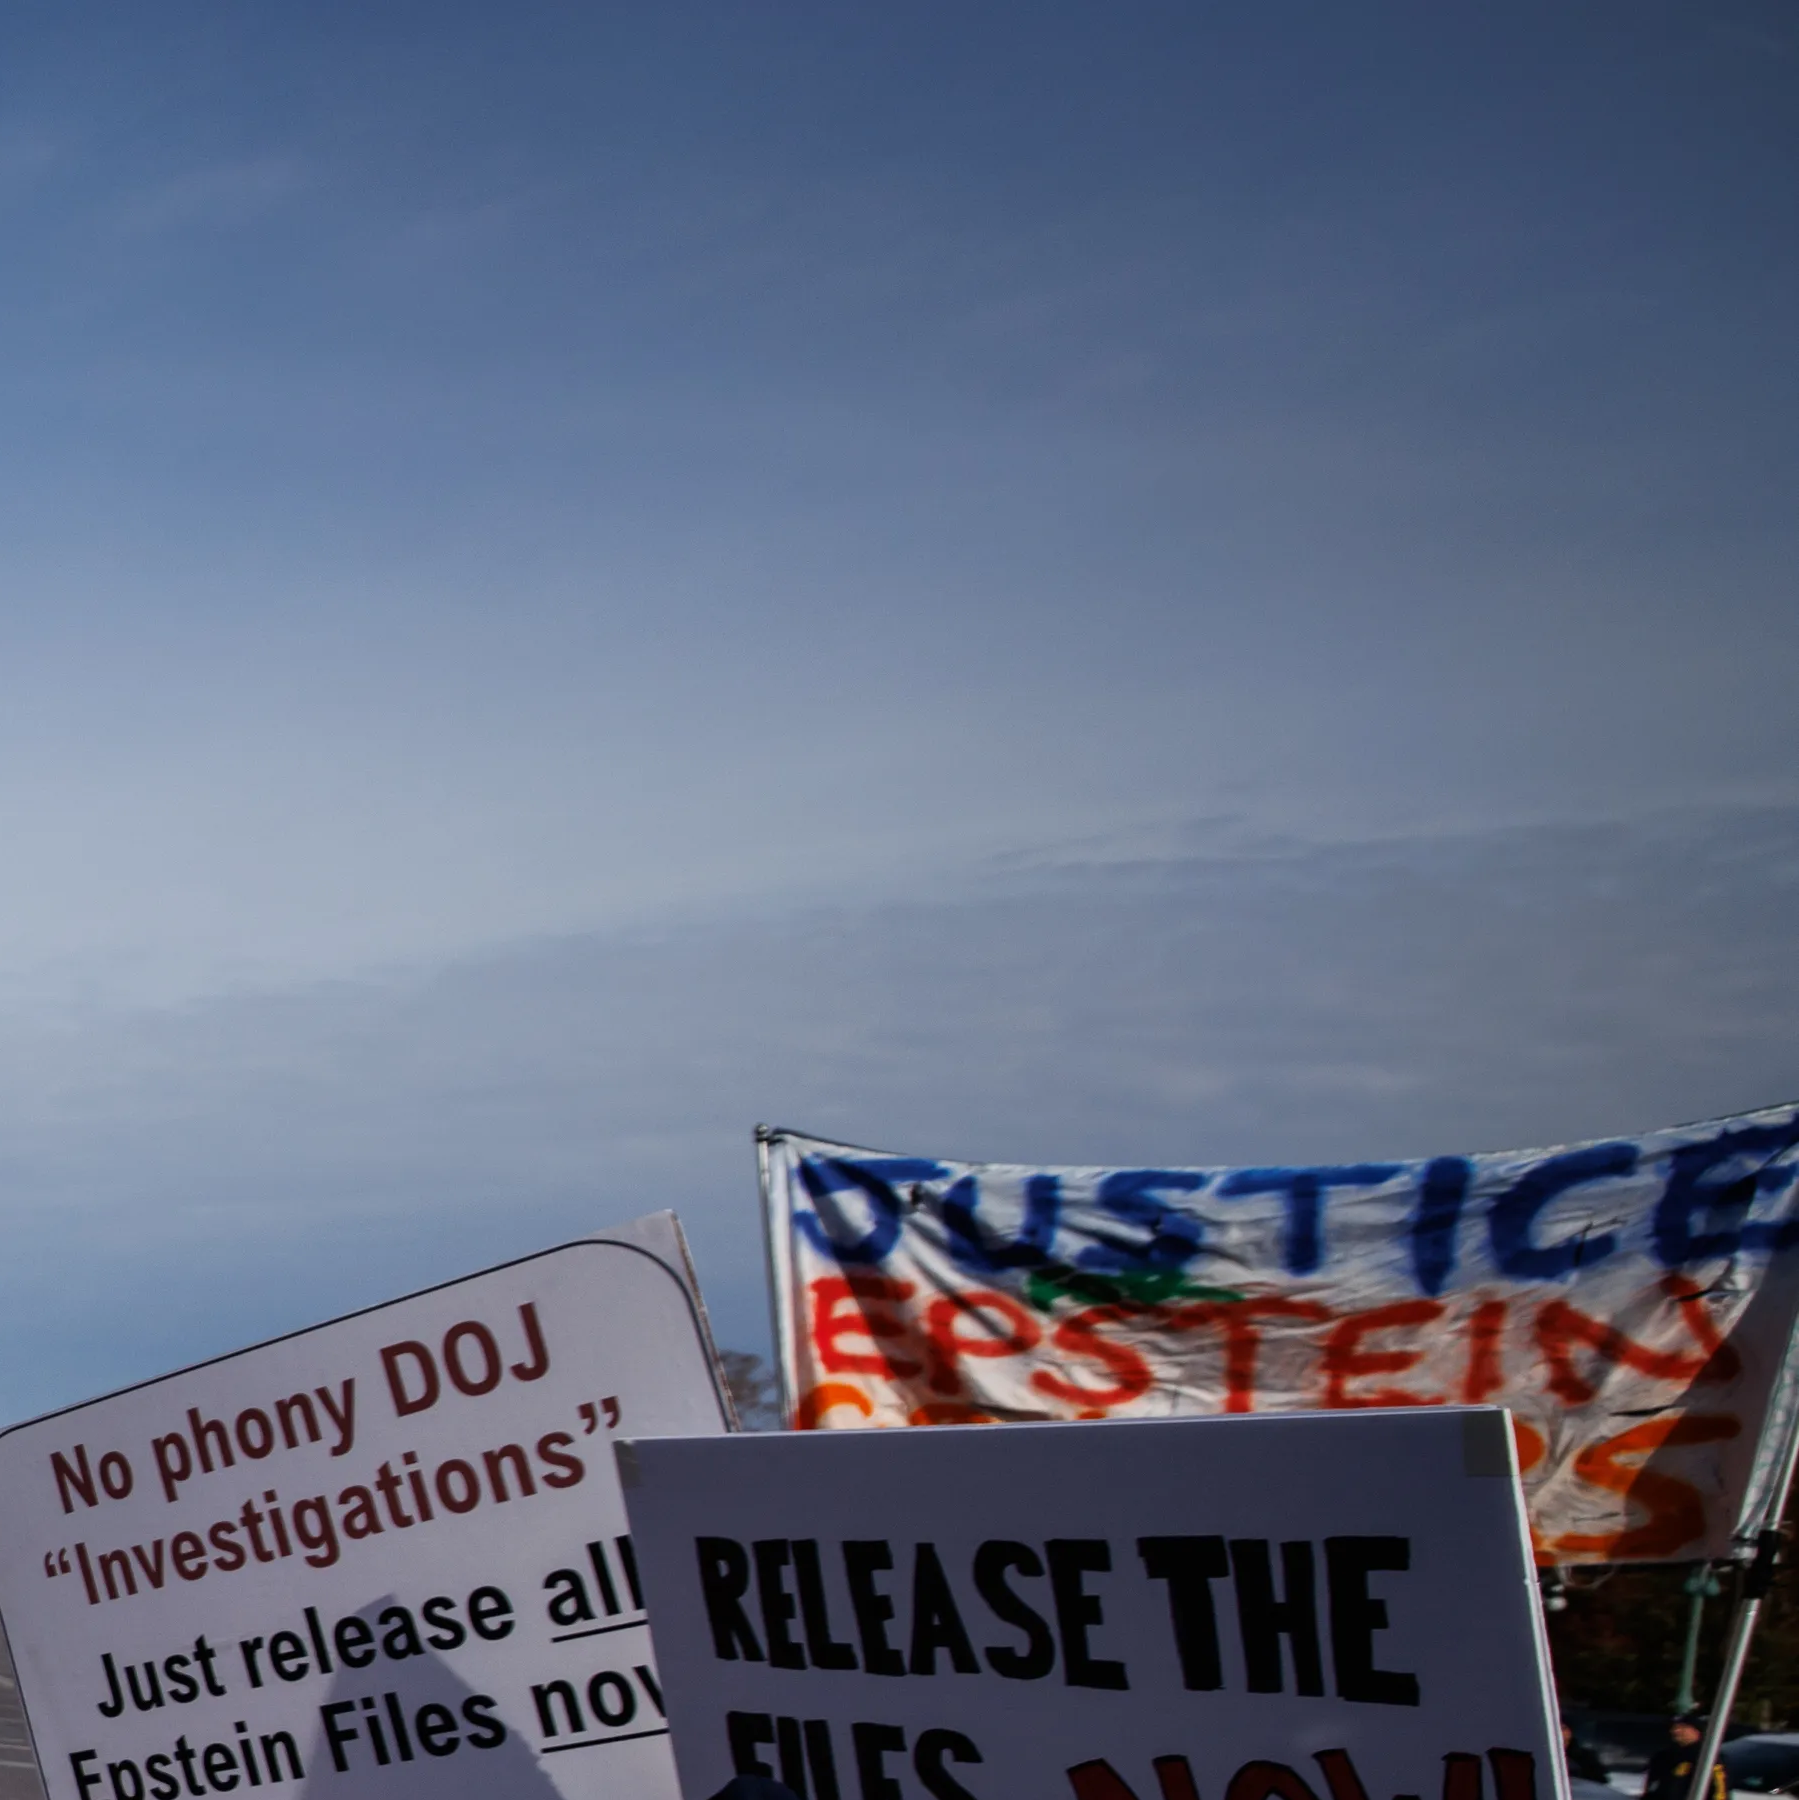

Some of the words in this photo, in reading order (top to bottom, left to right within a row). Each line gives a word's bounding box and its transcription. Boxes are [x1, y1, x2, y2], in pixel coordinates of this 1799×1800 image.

[798, 1111, 1799, 1297] JUSTICE
[50, 1443, 133, 1514] No
[152, 1378, 356, 1502] phony
[380, 1302, 550, 1418] DOJ
[812, 1272, 1740, 1412] EPSTEIN
[43, 1395, 621, 1605] “Investigations”
[97, 1636, 226, 1719] Just
[241, 1585, 515, 1689] release
[542, 1533, 645, 1627] all
[695, 1535, 1130, 1690] RELEASE
[1138, 1535, 1420, 1706] THE
[322, 1692, 506, 1773] Files
